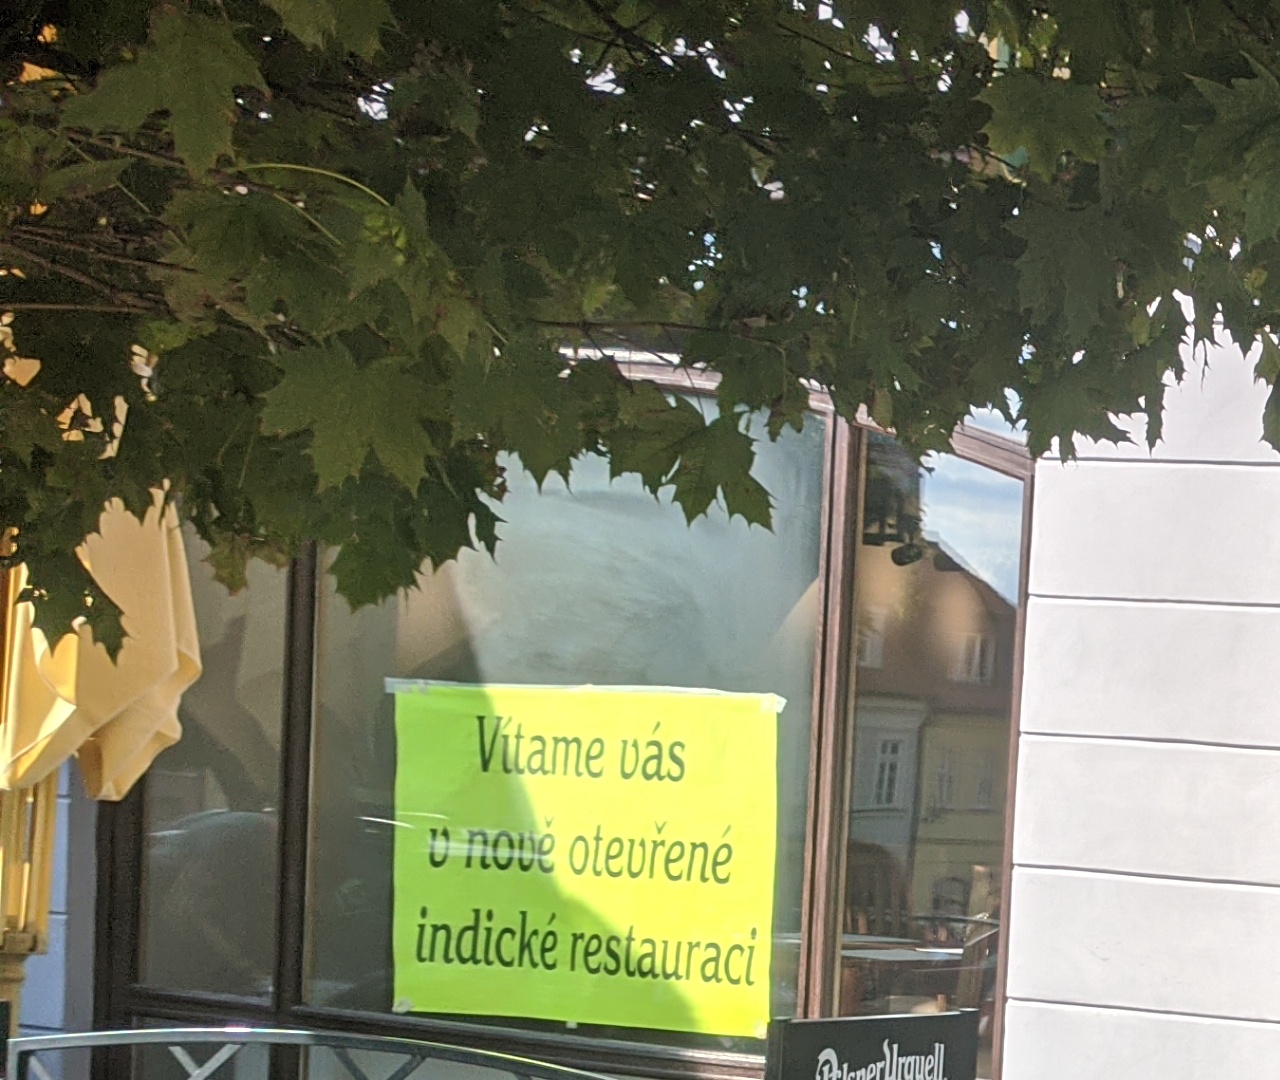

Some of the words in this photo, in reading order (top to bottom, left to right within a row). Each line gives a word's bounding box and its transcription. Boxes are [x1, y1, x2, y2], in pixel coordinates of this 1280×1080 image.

[475, 714, 606, 779] Vítame
[619, 720, 686, 783] vás
[428, 825, 451, 869] v
[464, 815, 556, 875] nově
[568, 820, 734, 885] otevřené
[415, 905, 559, 972] indické
[569, 924, 758, 987] restauraci
